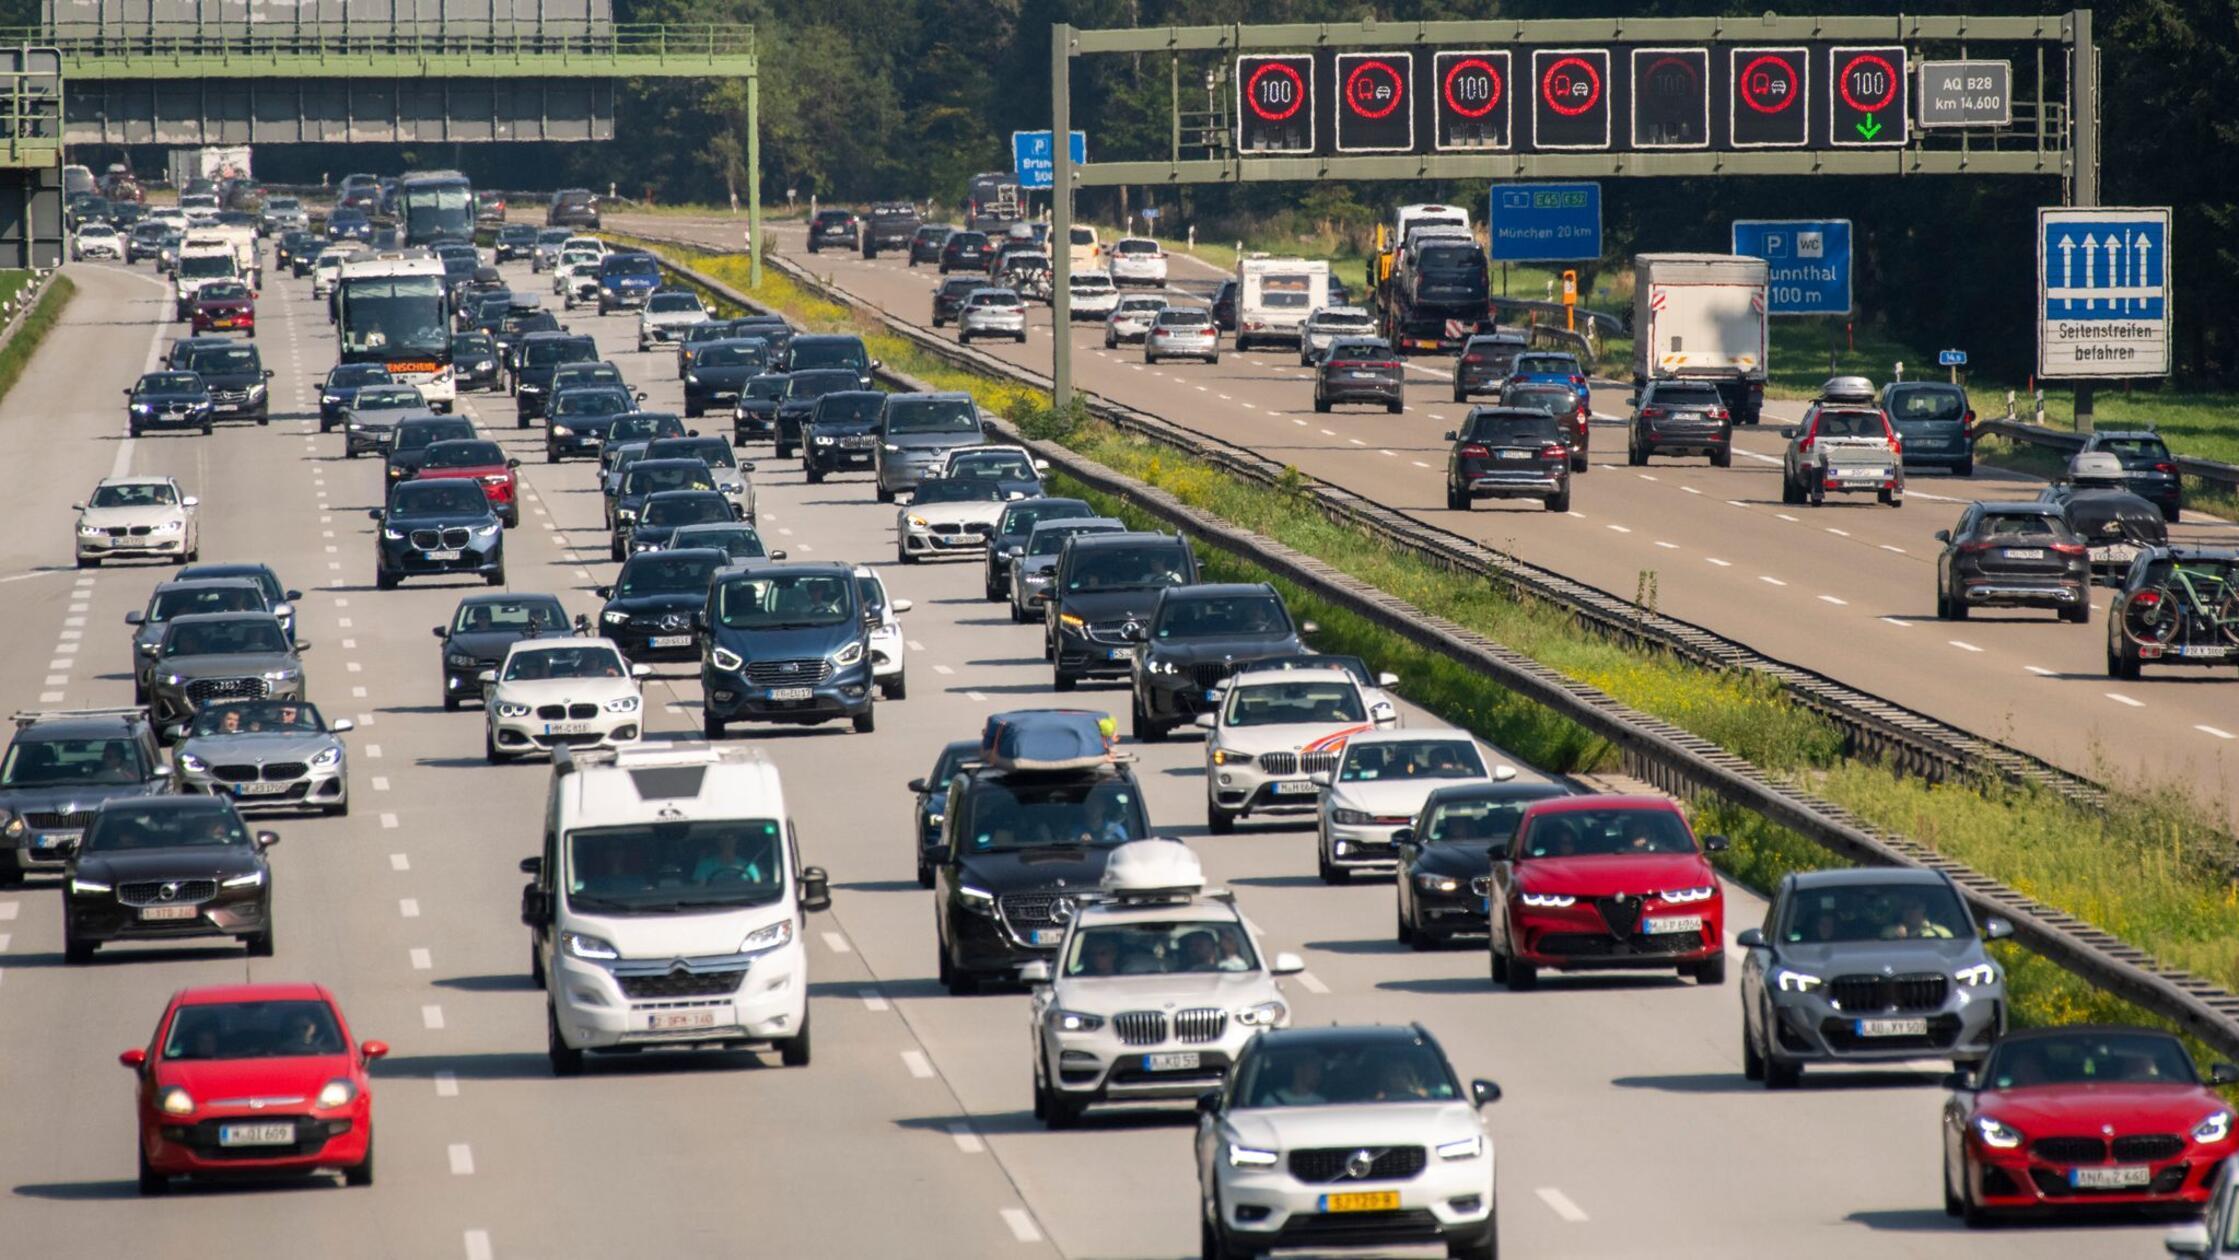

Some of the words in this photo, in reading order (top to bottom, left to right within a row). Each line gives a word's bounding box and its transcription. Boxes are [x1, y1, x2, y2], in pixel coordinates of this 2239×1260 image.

[1458, 76, 1488, 100] 100
[1853, 72, 1884, 96] 100
[1943, 77, 1962, 90] AQ
[1967, 76, 1993, 90] B28
[1261, 80, 1291, 103] 100
[1935, 97, 1957, 110] km
[1535, 194, 1558, 206] E45
[1499, 226, 1553, 239] München
[1557, 225, 1572, 238] 20
[1573, 225, 1592, 238] km
[1768, 235, 1782, 254] P
[1800, 240, 1819, 250] WC
[1770, 265, 1837, 281] unnthal
[1806, 290, 1822, 303] m
[2059, 322, 2152, 339] Seitenstreifen
[2075, 344, 2135, 361] befahren
